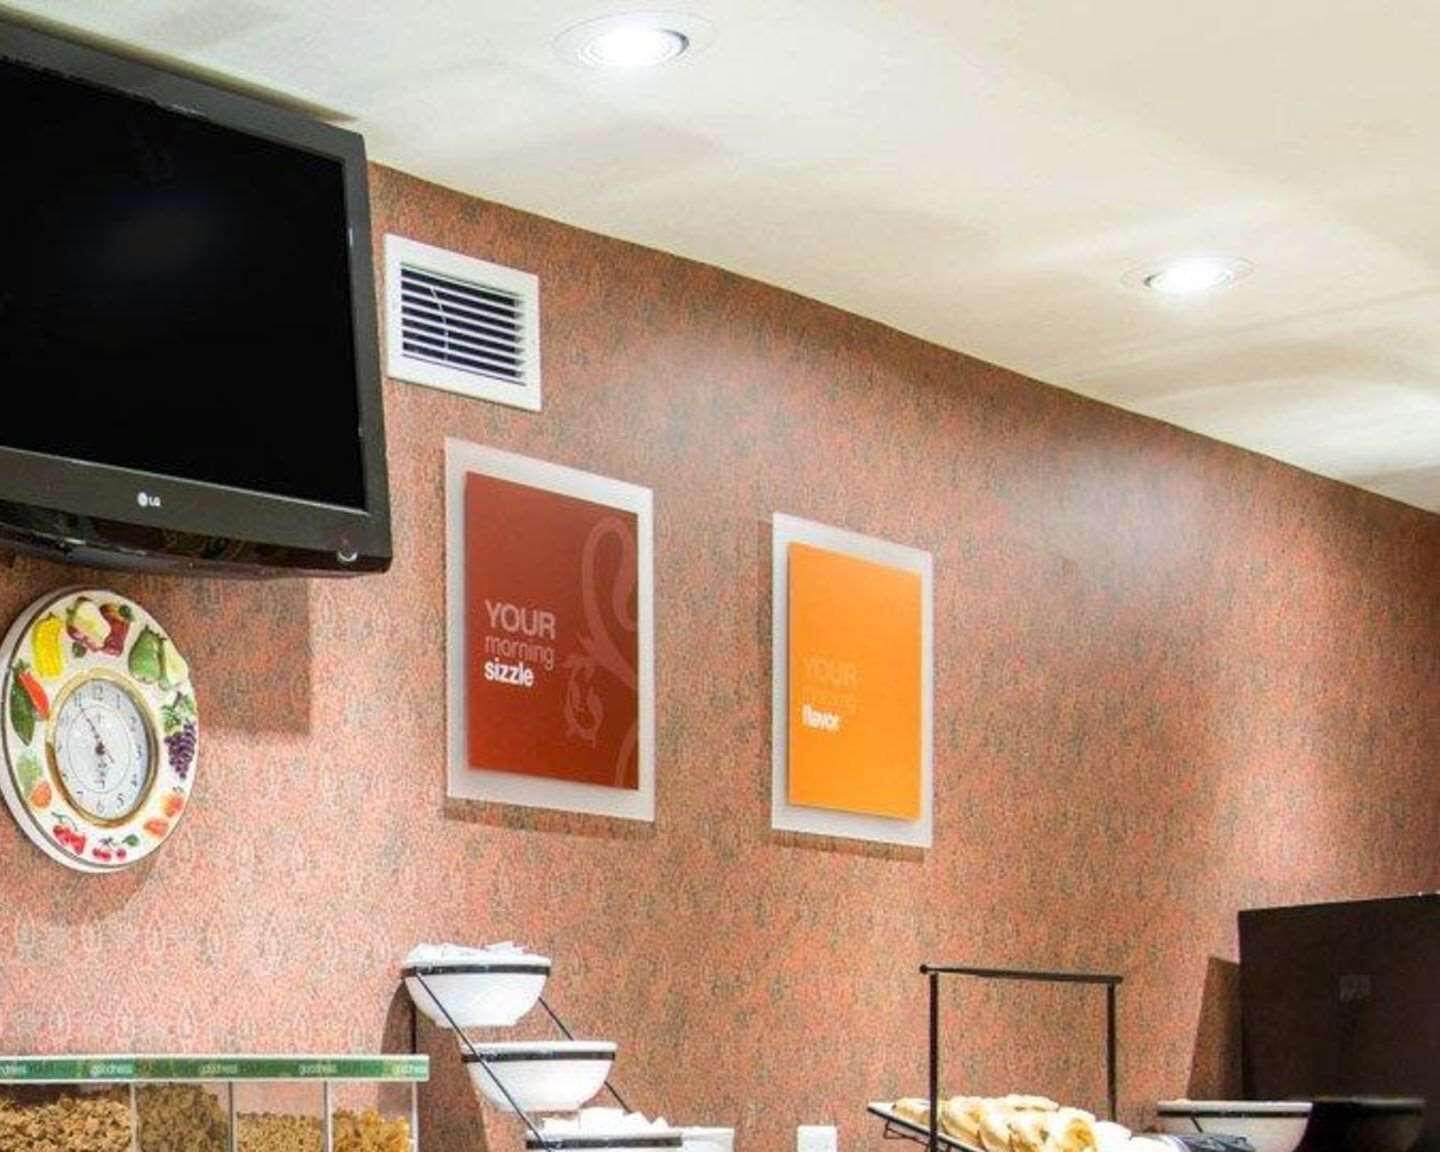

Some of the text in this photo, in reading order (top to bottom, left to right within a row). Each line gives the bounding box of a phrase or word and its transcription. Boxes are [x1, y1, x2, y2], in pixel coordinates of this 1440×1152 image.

[484, 599, 556, 640] YOUR
[484, 635, 555, 671] morning
[484, 657, 534, 687] sizzle
